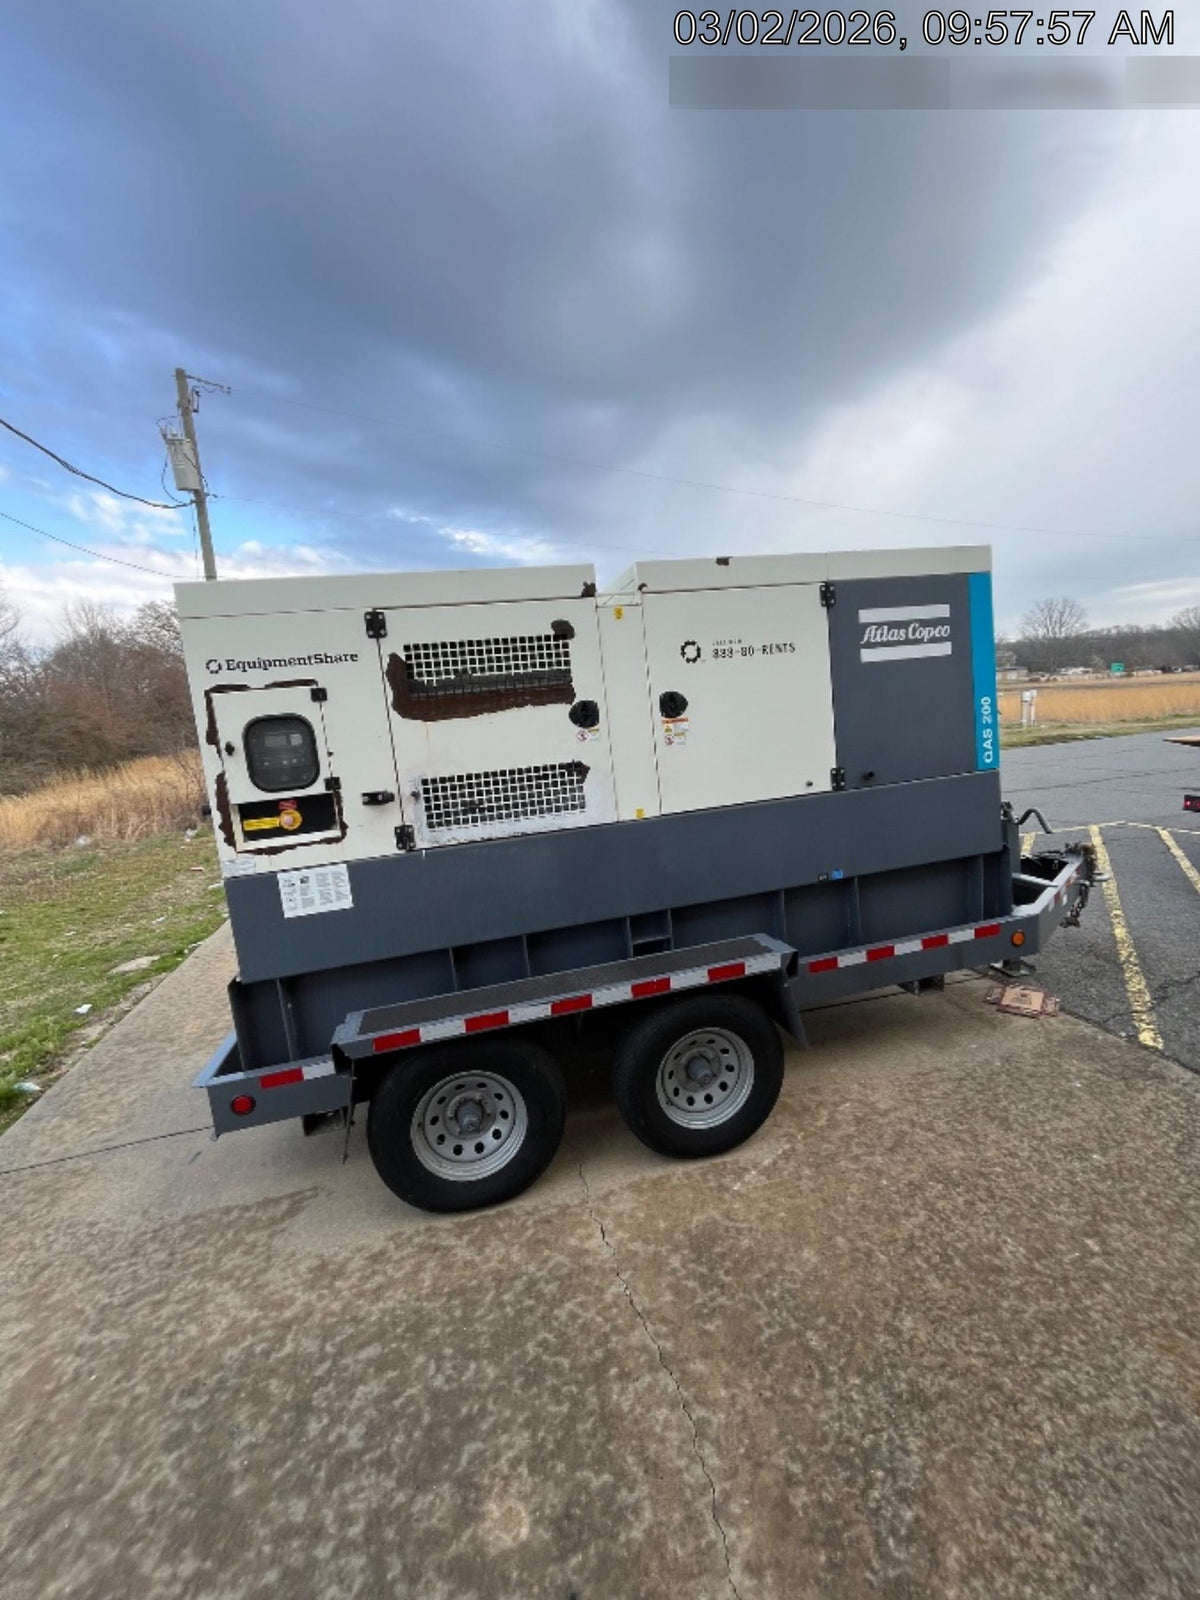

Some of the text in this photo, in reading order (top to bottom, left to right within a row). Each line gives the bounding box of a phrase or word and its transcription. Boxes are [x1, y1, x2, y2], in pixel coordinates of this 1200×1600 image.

[860, 622, 950, 644] Atlas Copco
[225, 653, 359, 673] EquipmentShare
[980, 696, 993, 764] QAS 200
